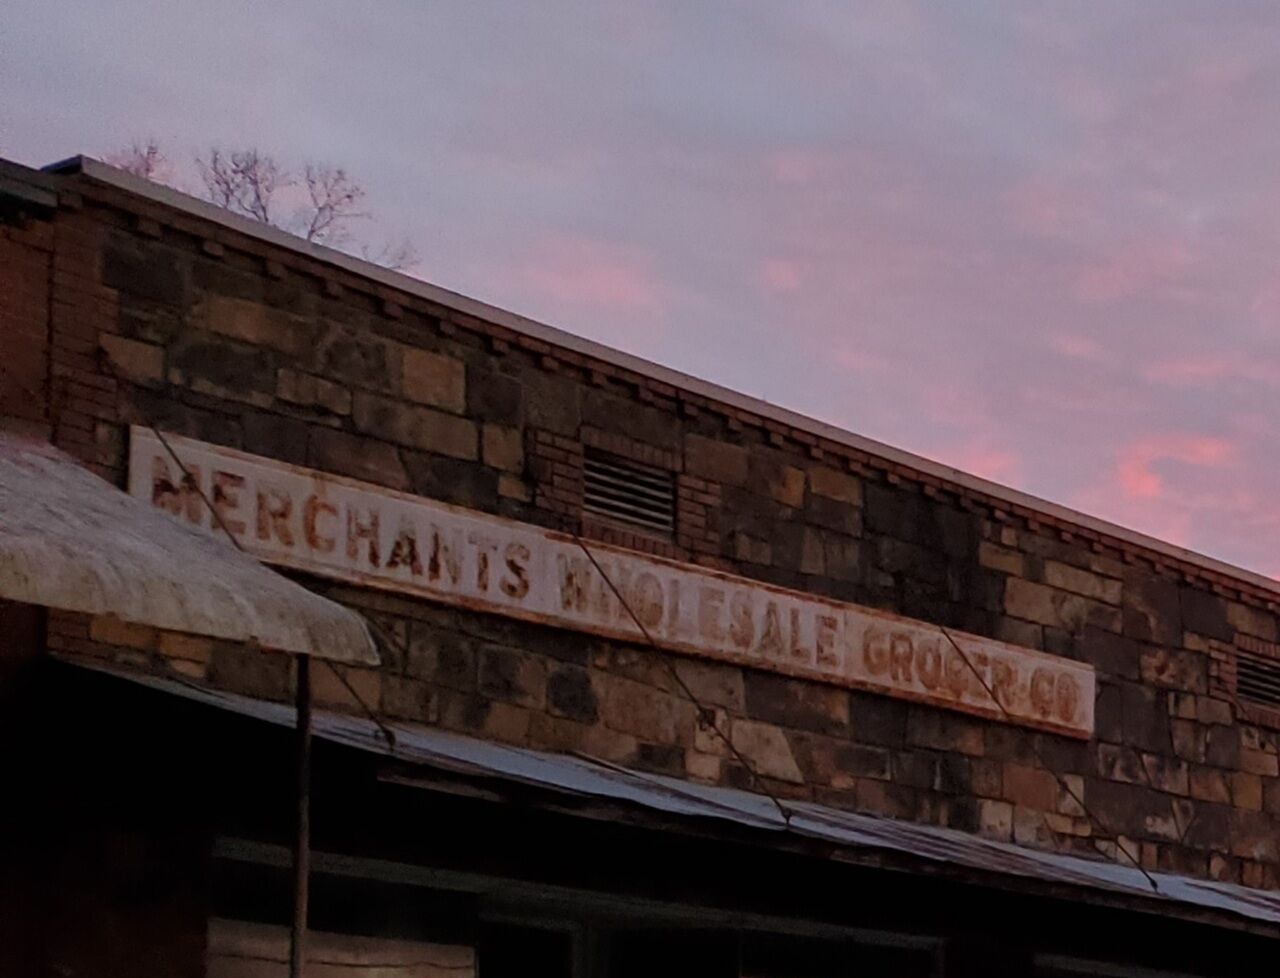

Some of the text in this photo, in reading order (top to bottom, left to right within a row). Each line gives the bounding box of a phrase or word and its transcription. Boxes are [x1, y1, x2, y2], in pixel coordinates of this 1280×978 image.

[151, 456, 531, 599] MERCHANTS
[556, 552, 839, 667] WHOLESALE
[862, 622, 1016, 707] GROCER
